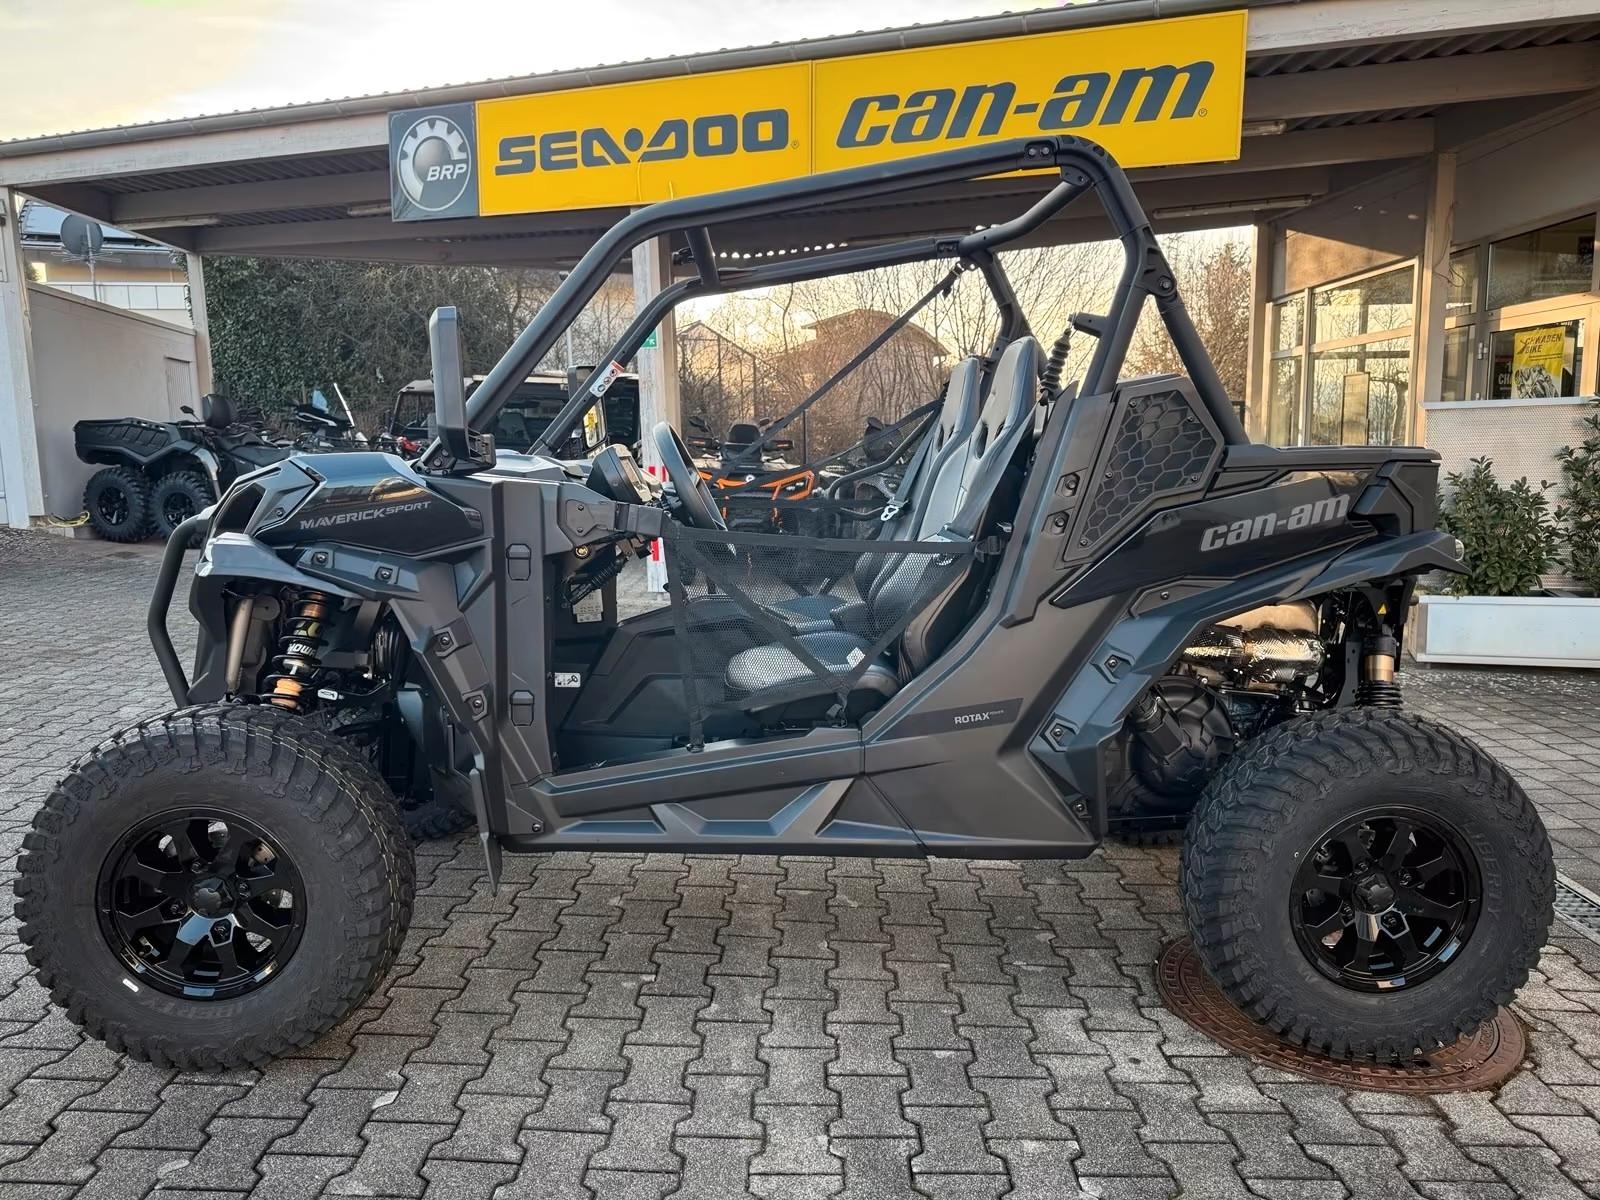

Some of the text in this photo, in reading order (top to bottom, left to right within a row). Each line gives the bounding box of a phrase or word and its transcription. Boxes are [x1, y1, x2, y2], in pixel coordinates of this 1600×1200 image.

[836, 60, 1215, 149] can-am
[426, 163, 467, 181] BRP
[299, 501, 431, 530] MAVERICK SPORT
[1200, 494, 1350, 552] can-am
[954, 711, 990, 725] ROTAX
